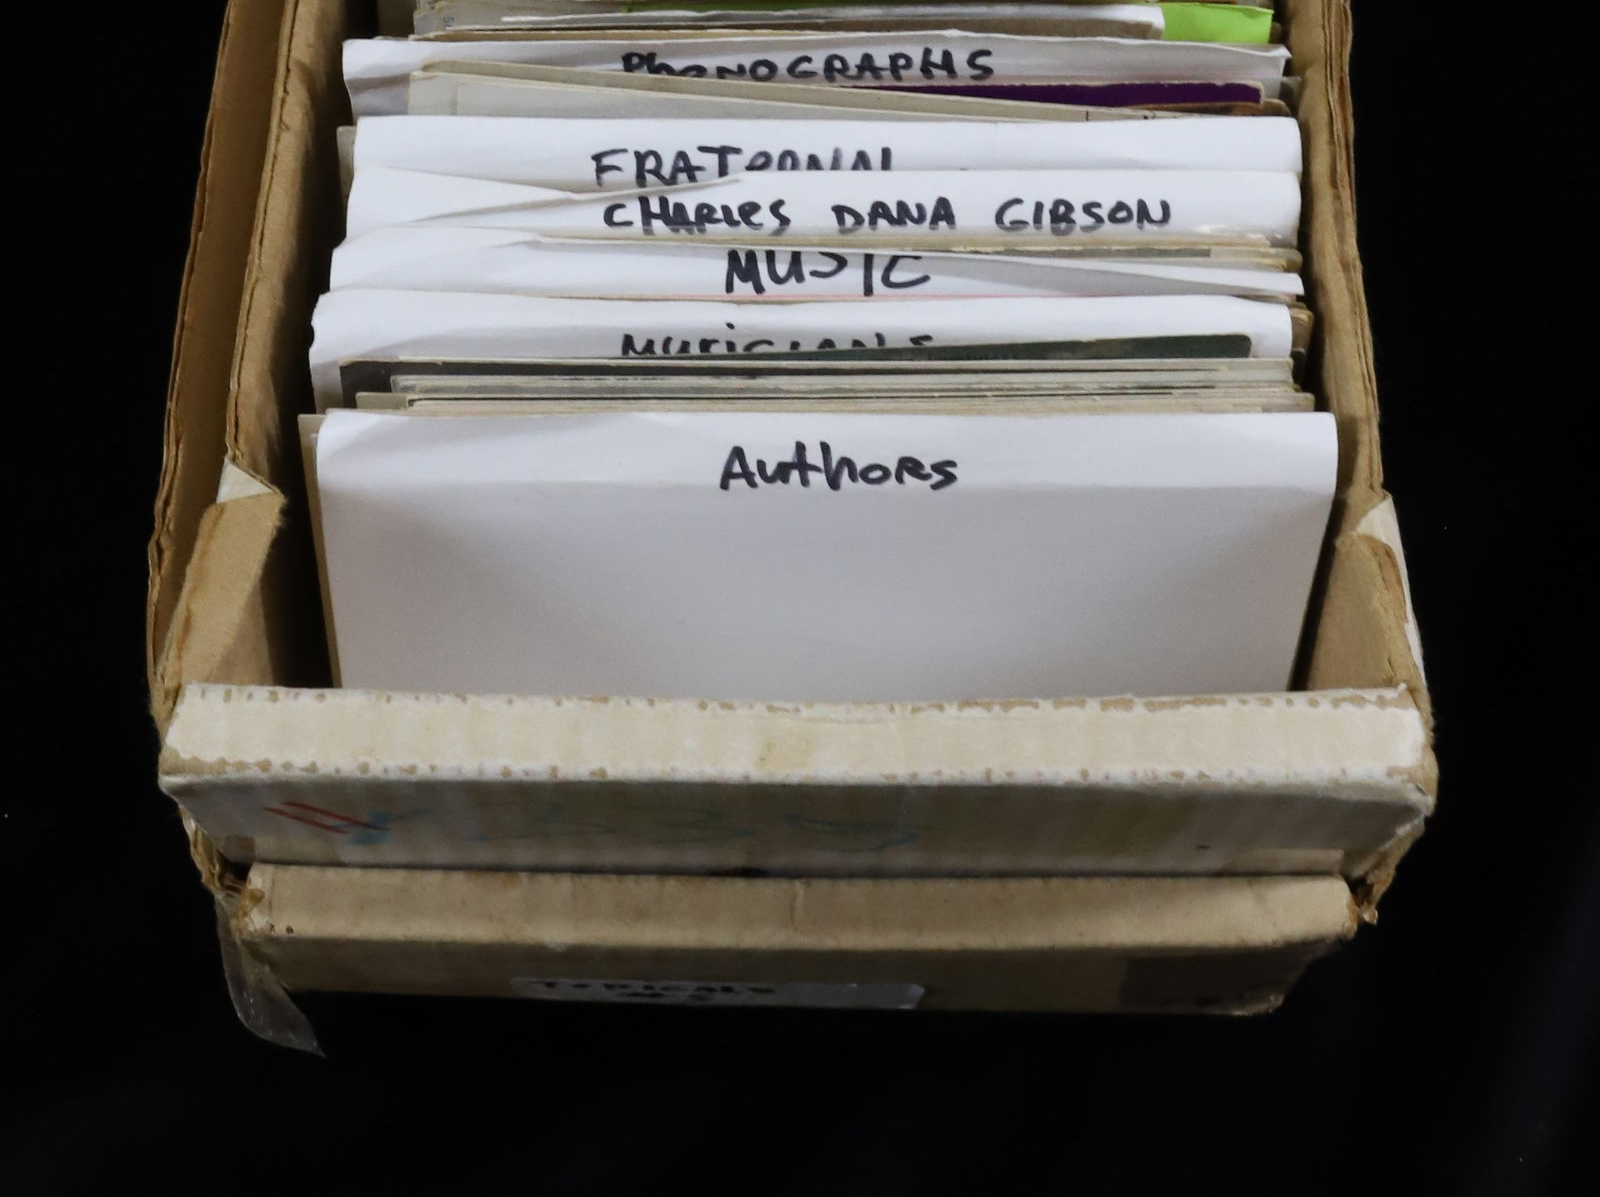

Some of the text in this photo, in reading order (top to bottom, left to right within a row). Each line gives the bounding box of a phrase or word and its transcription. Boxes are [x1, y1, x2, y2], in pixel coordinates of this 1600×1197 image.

[831, 196, 957, 235] DANA
[994, 198, 1172, 236] GIBSON
[725, 249, 931, 297] MUSIC
